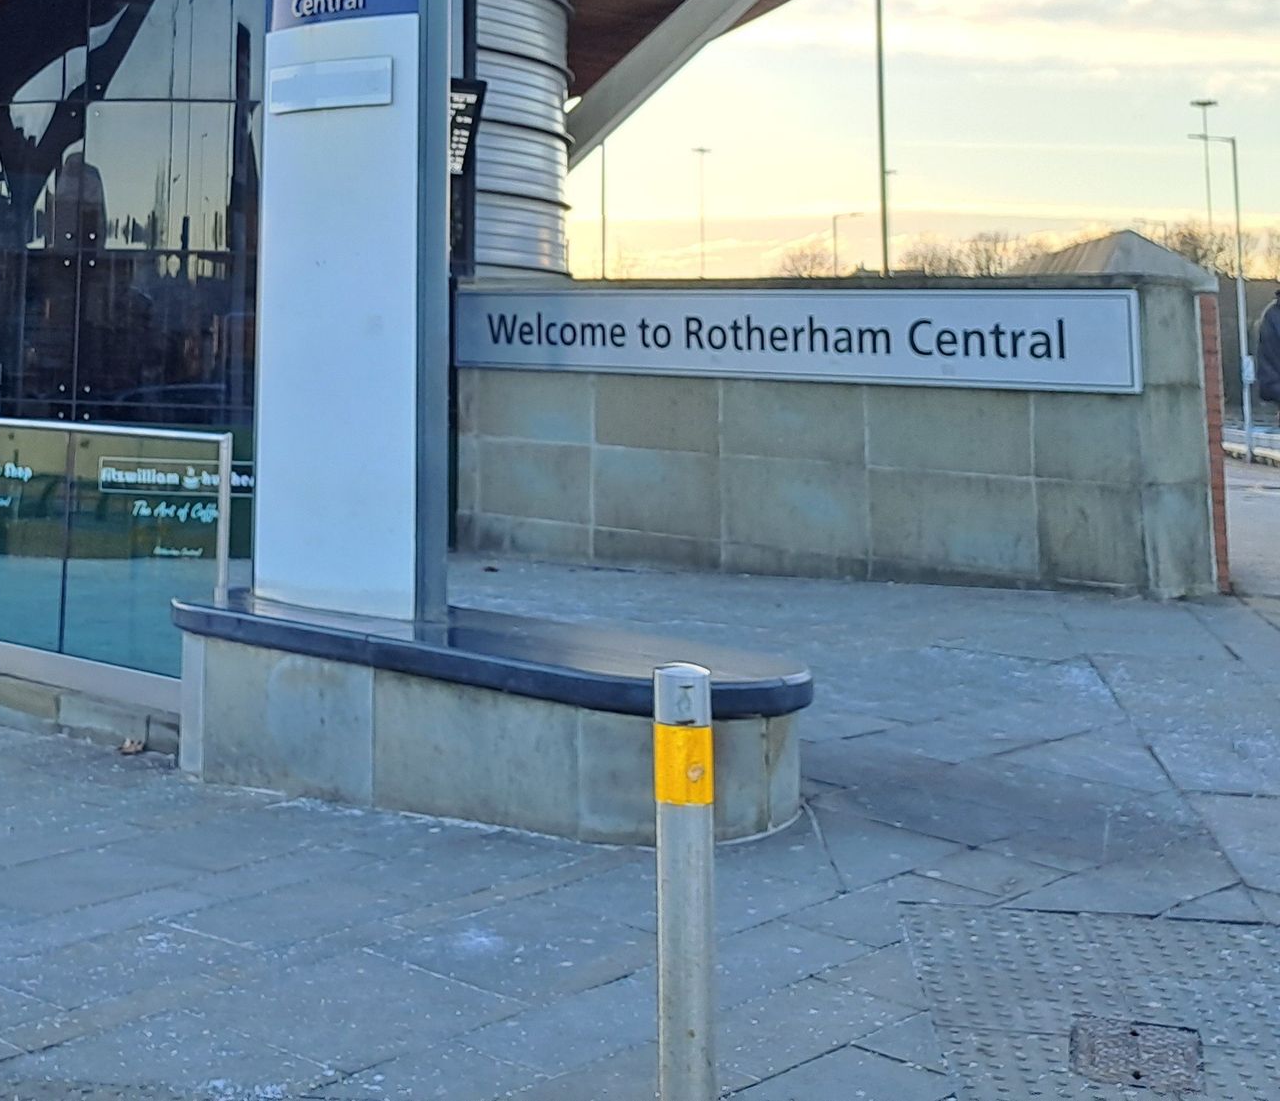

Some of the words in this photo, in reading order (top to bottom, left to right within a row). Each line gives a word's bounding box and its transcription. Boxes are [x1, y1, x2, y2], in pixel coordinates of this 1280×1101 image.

[487, 312, 626, 347] Welcome
[638, 318, 671, 348] to
[685, 314, 891, 355] Rotherham
[908, 318, 1066, 359] Central
[4, 462, 32, 482] Shop
